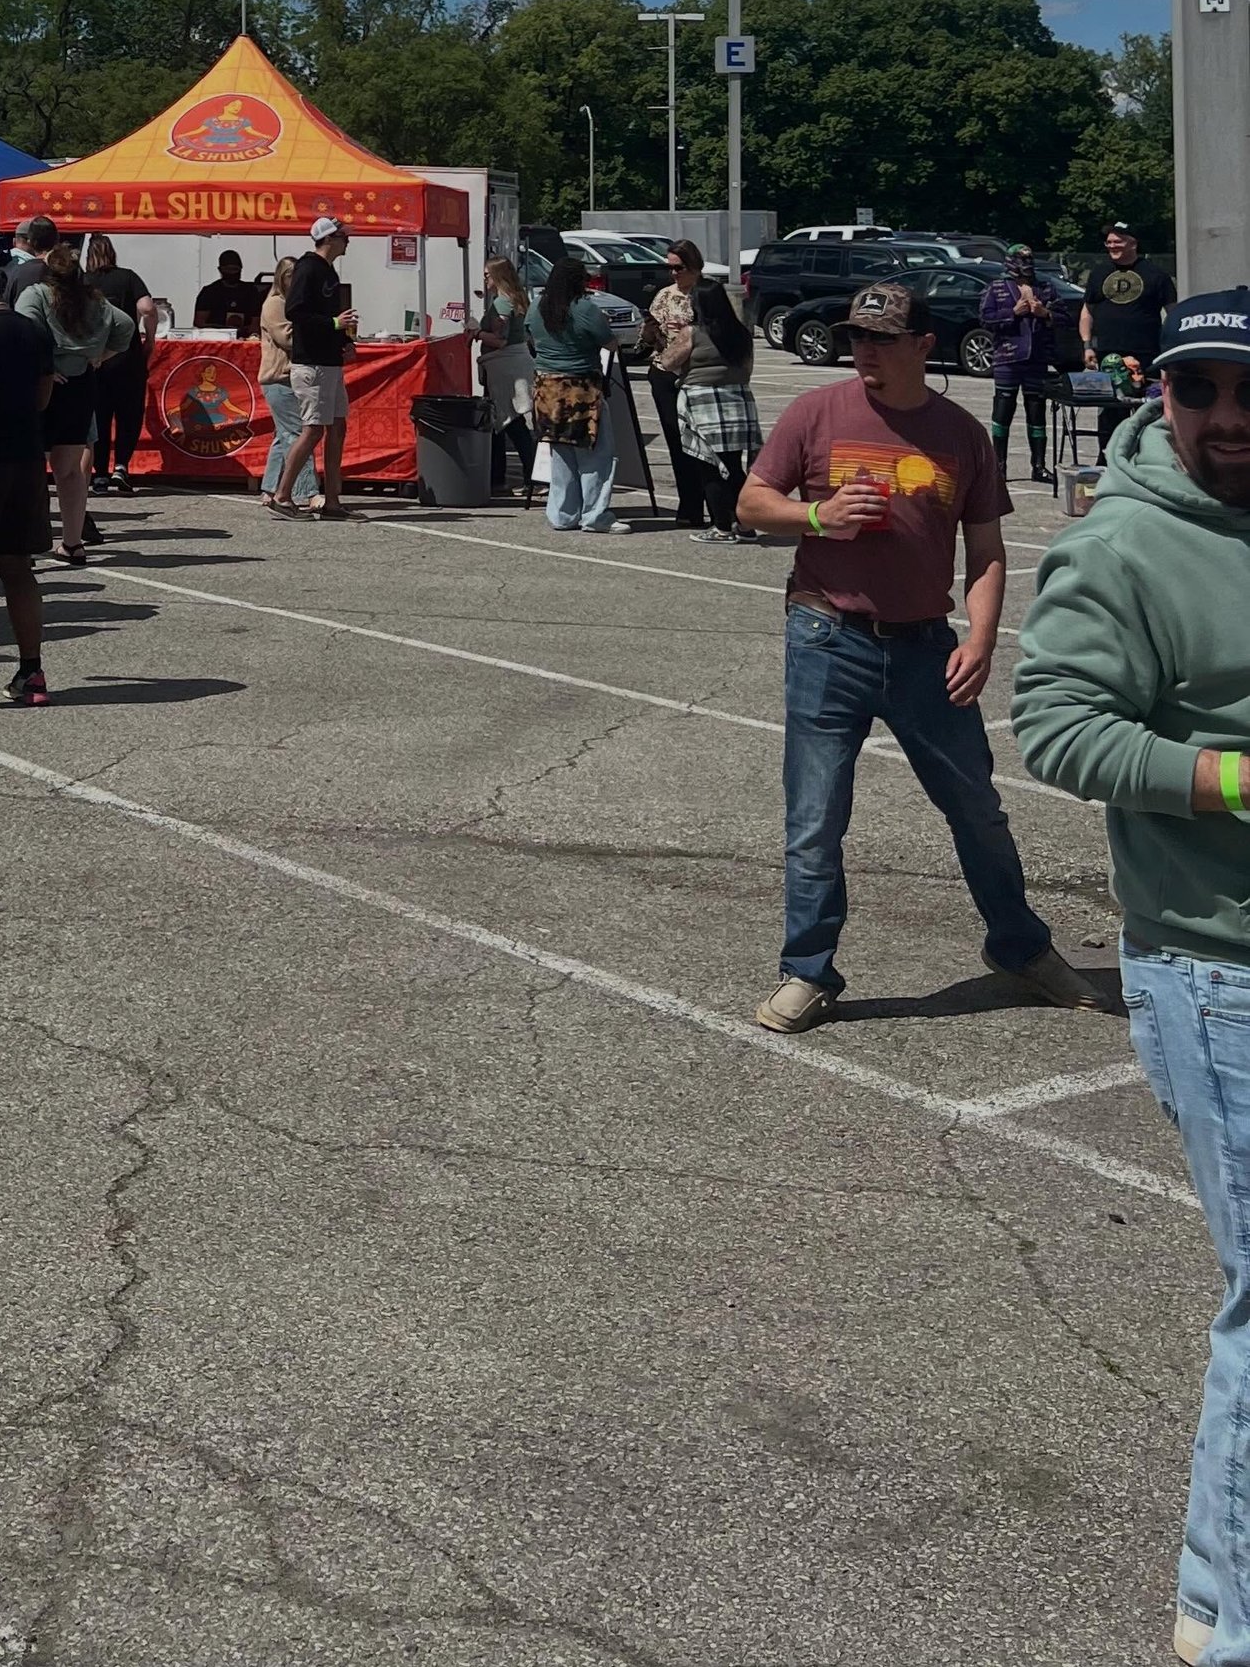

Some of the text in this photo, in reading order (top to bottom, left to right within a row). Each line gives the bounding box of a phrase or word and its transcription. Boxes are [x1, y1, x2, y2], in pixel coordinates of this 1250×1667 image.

[726, 42, 746, 66] E
[173, 146, 268, 161] LA SHUNCA
[114, 191, 300, 222] LA SHUNCA
[1178, 313, 1248, 332] DRINK
[190, 429, 249, 454] SHUNCA
